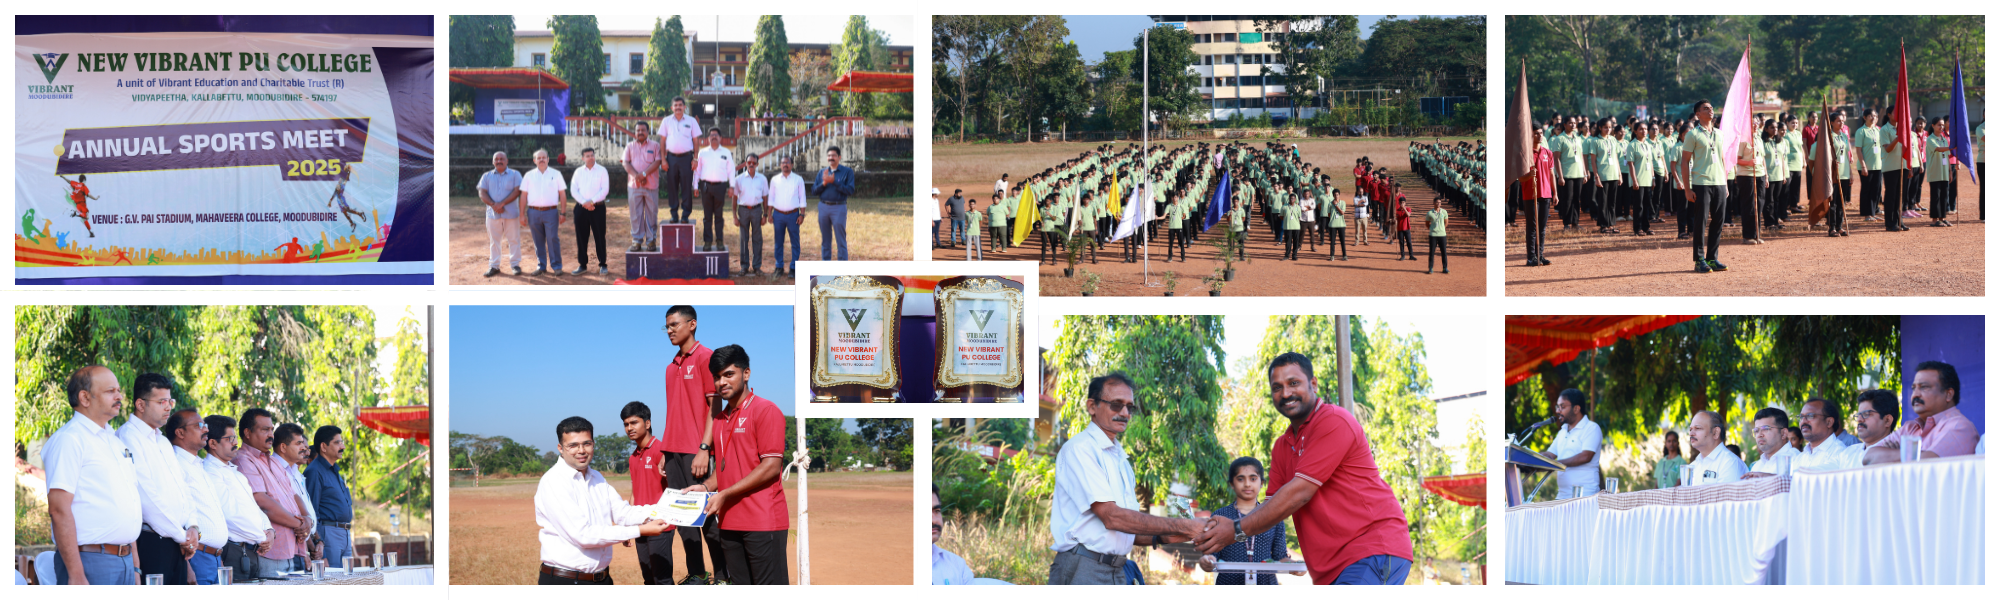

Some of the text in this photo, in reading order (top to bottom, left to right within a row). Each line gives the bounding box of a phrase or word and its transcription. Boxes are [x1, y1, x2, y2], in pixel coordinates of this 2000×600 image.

[77, 52, 372, 73] NEW VIBRANT PU COLLEGE
[27, 84, 74, 94] VIBRANT
[116, 77, 345, 90] A unit of Vibrant Education and Charitable Trust (R)
[132, 93, 189, 102] VIDYAPEETHA,
[191, 93, 244, 102] KALLABETTU,
[246, 93, 303, 102] MOODUBIDIRE
[311, 94, 338, 102] 574197
[68, 128, 349, 160] ANNUAL SPORTS MEET
[287, 158, 342, 177] 2025
[91, 214, 119, 225] VENUE
[124, 214, 140, 224] G.V.
[141, 214, 154, 224] PAI
[156, 213, 194, 225] STADIUM,
[195, 212, 245, 223] MAHAVEERA
[245, 212, 282, 223] COLLEGE,
[282, 211, 338, 222] MOODUBIDIRE
